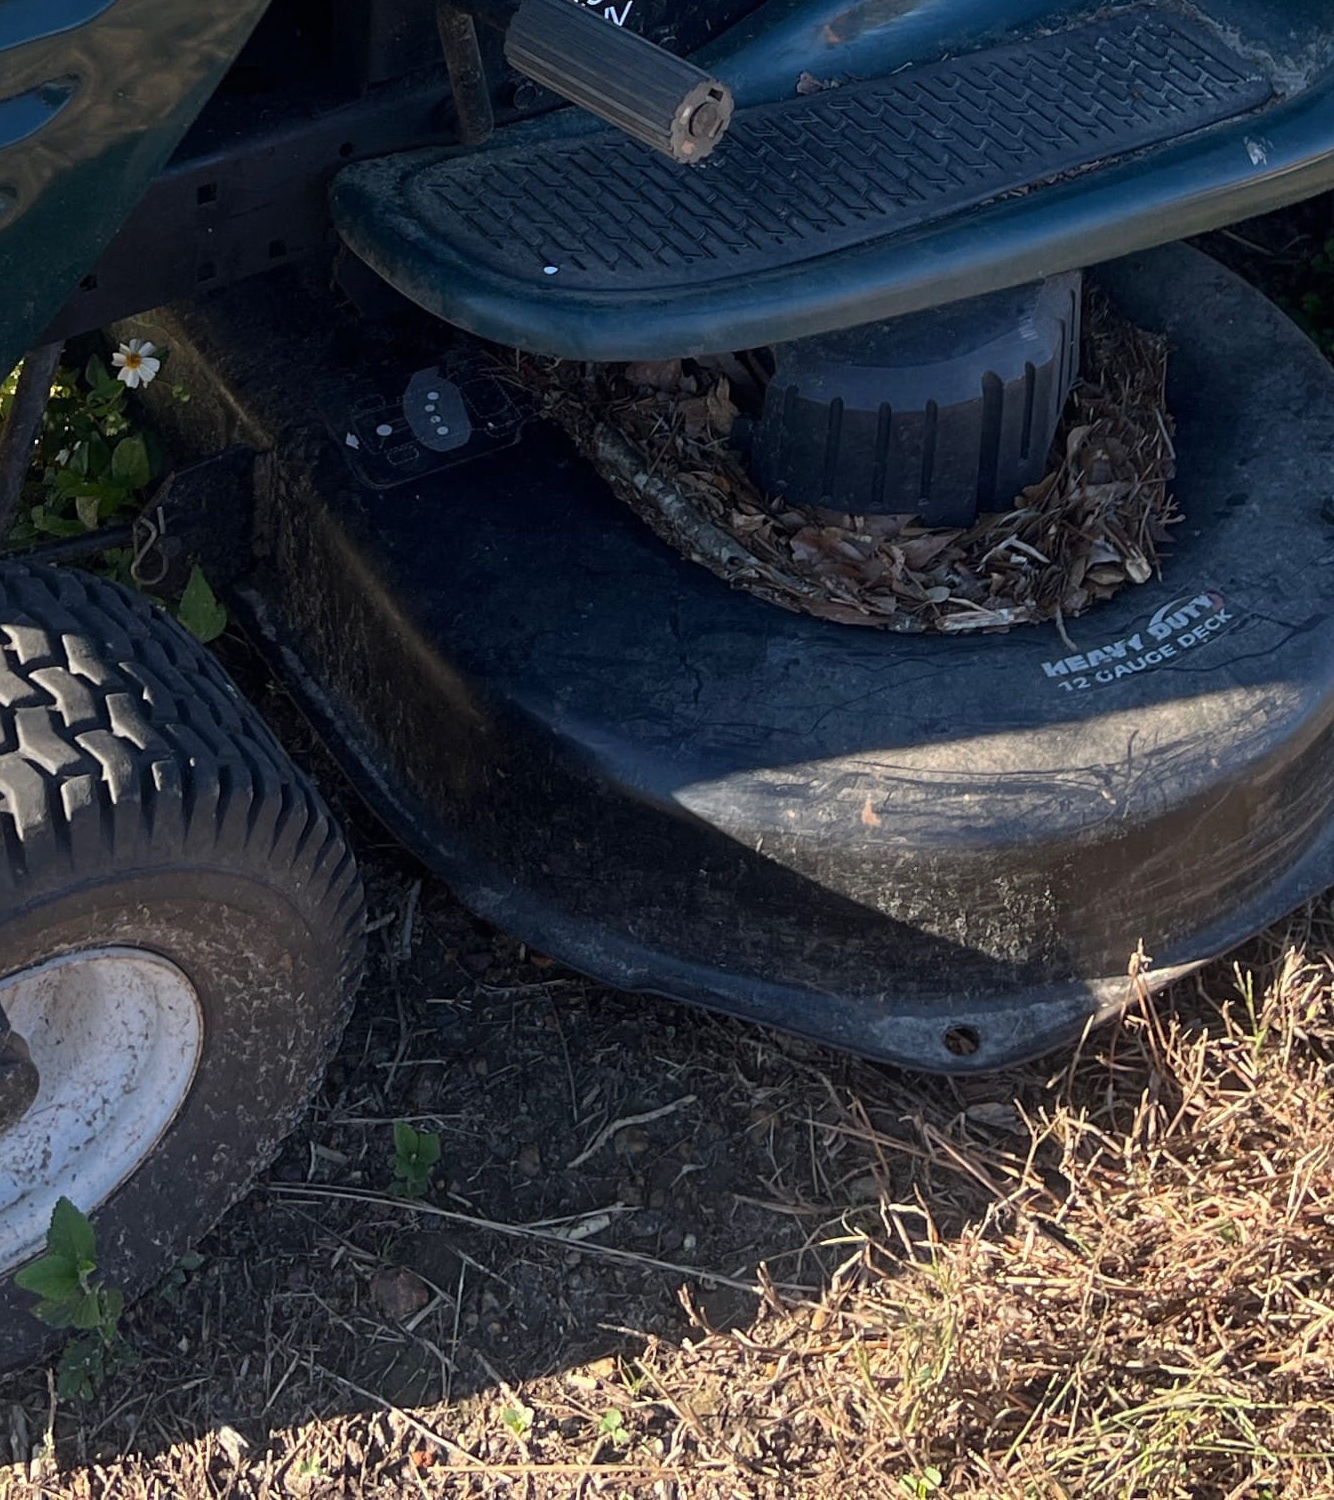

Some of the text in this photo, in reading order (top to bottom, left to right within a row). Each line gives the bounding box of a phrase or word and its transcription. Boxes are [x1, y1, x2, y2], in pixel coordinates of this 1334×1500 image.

[1041, 593, 1214, 677] HEAVY DUTY
[1058, 609, 1233, 691] 12 GAUGE DECK
